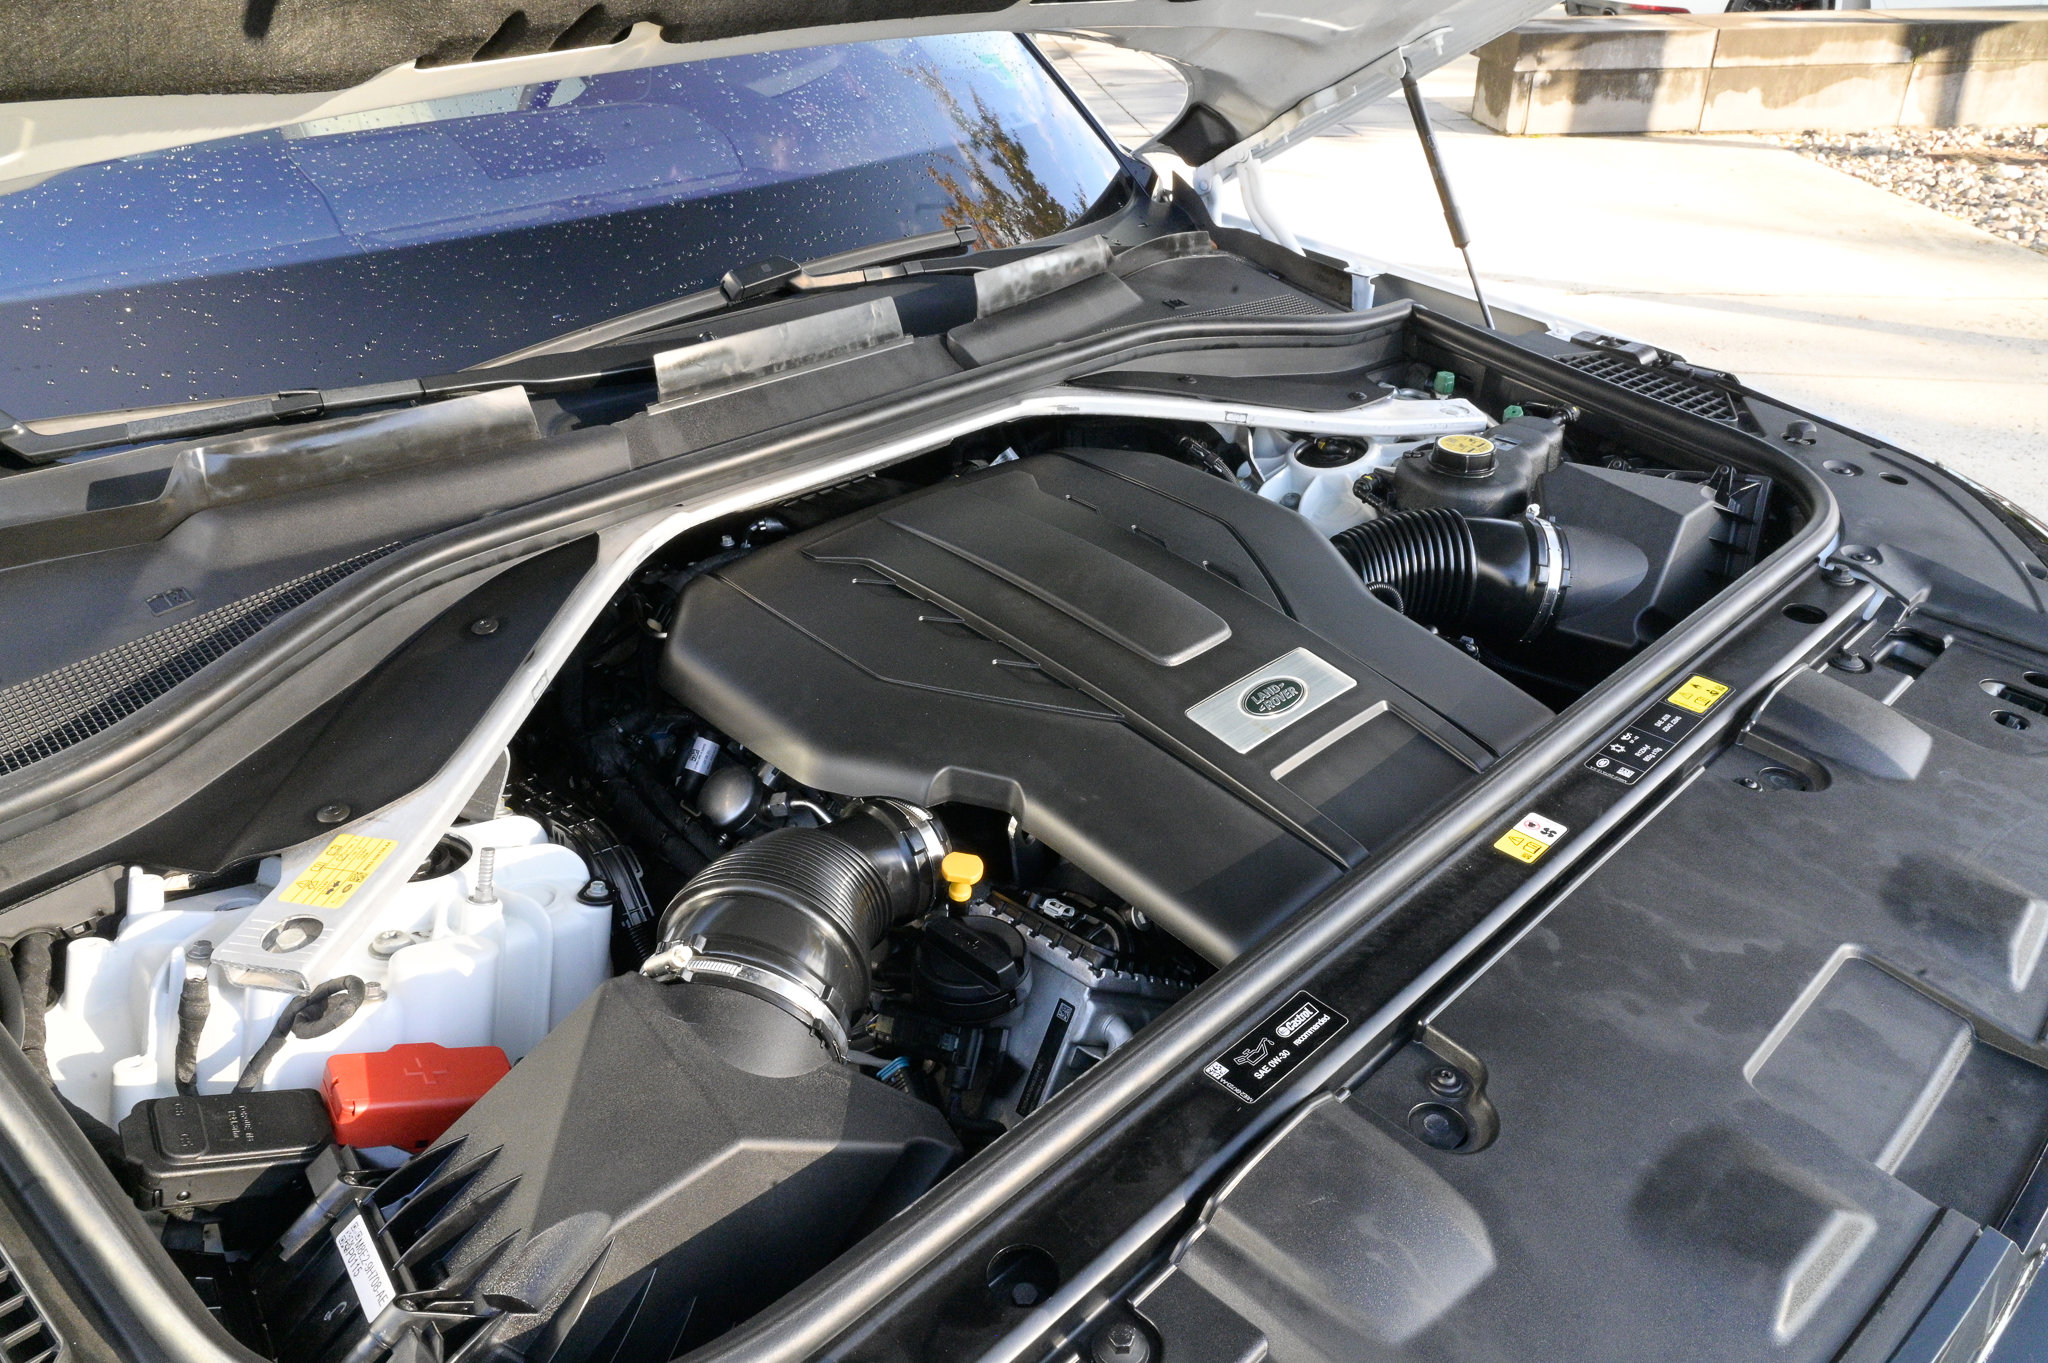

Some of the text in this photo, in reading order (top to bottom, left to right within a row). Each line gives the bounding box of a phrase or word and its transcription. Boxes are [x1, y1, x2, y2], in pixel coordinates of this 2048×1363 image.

[1251, 683, 1282, 705] LAND
[1261, 686, 1299, 711] ROVER
[1285, 1006, 1314, 1032] Castrol
[1293, 1013, 1331, 1046] recommended
[1253, 1049, 1291, 1080] SAE 0W-30
